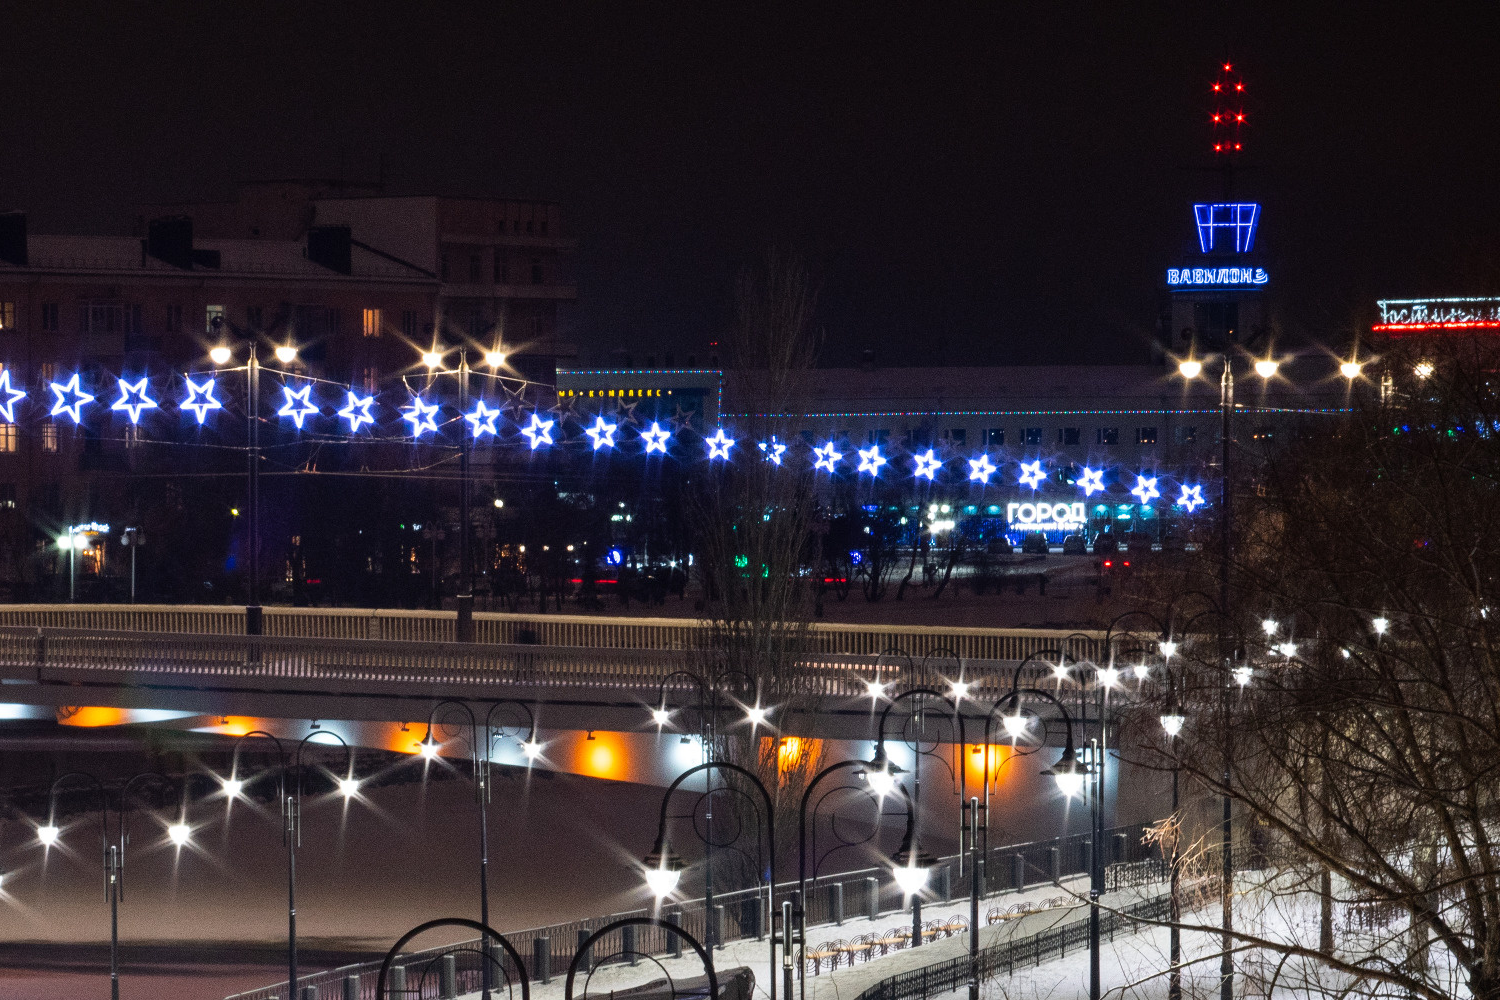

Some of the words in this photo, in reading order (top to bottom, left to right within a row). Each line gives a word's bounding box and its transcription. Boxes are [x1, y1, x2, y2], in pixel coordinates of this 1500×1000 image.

[1167, 268, 1253, 285] ВАВИЛОН
[588, 389, 661, 398] КОМПЛЕКС
[1007, 502, 1086, 523] ГОРОД
